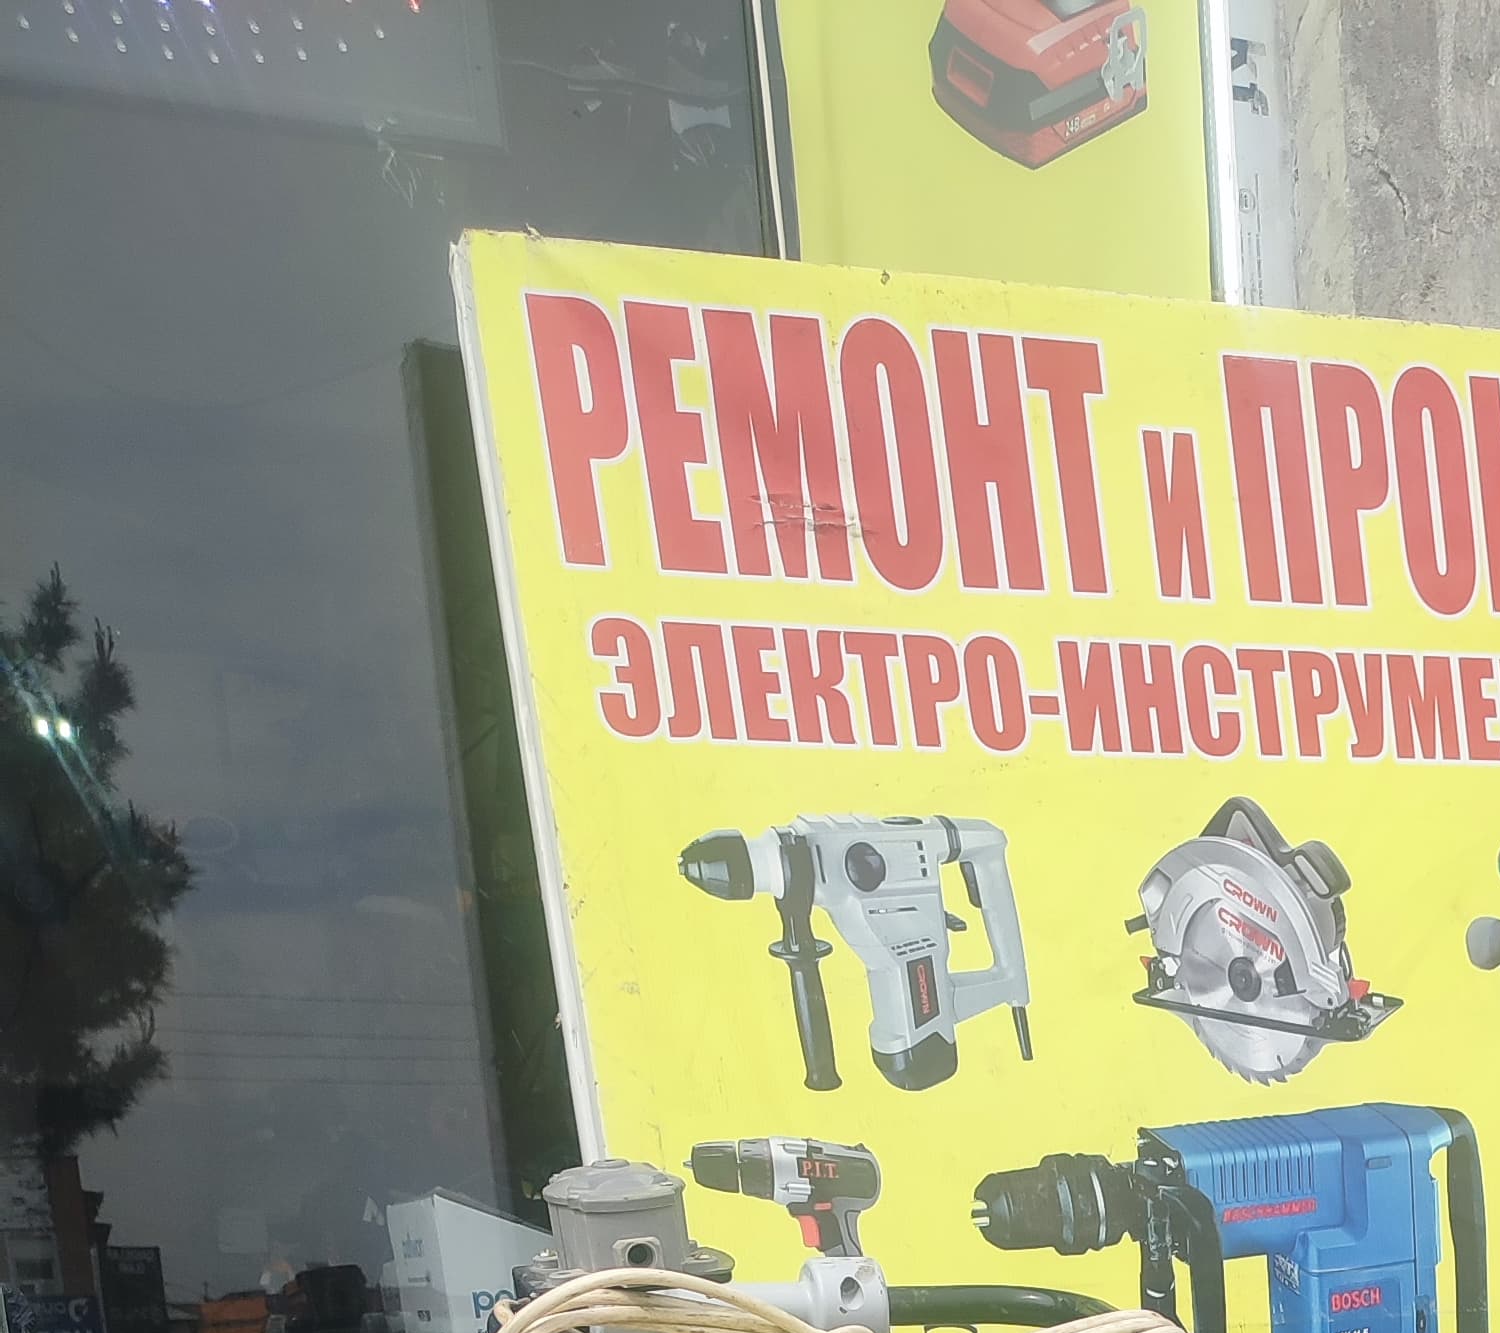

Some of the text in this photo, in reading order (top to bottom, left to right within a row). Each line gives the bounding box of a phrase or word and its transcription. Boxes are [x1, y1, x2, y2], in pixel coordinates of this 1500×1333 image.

[525, 292, 1109, 595] РЕМОНТ
[1223, 878, 1278, 922] CROWN
[801, 1160, 840, 1179] P.I.T.
[1330, 1287, 1382, 1313] BOSCH
